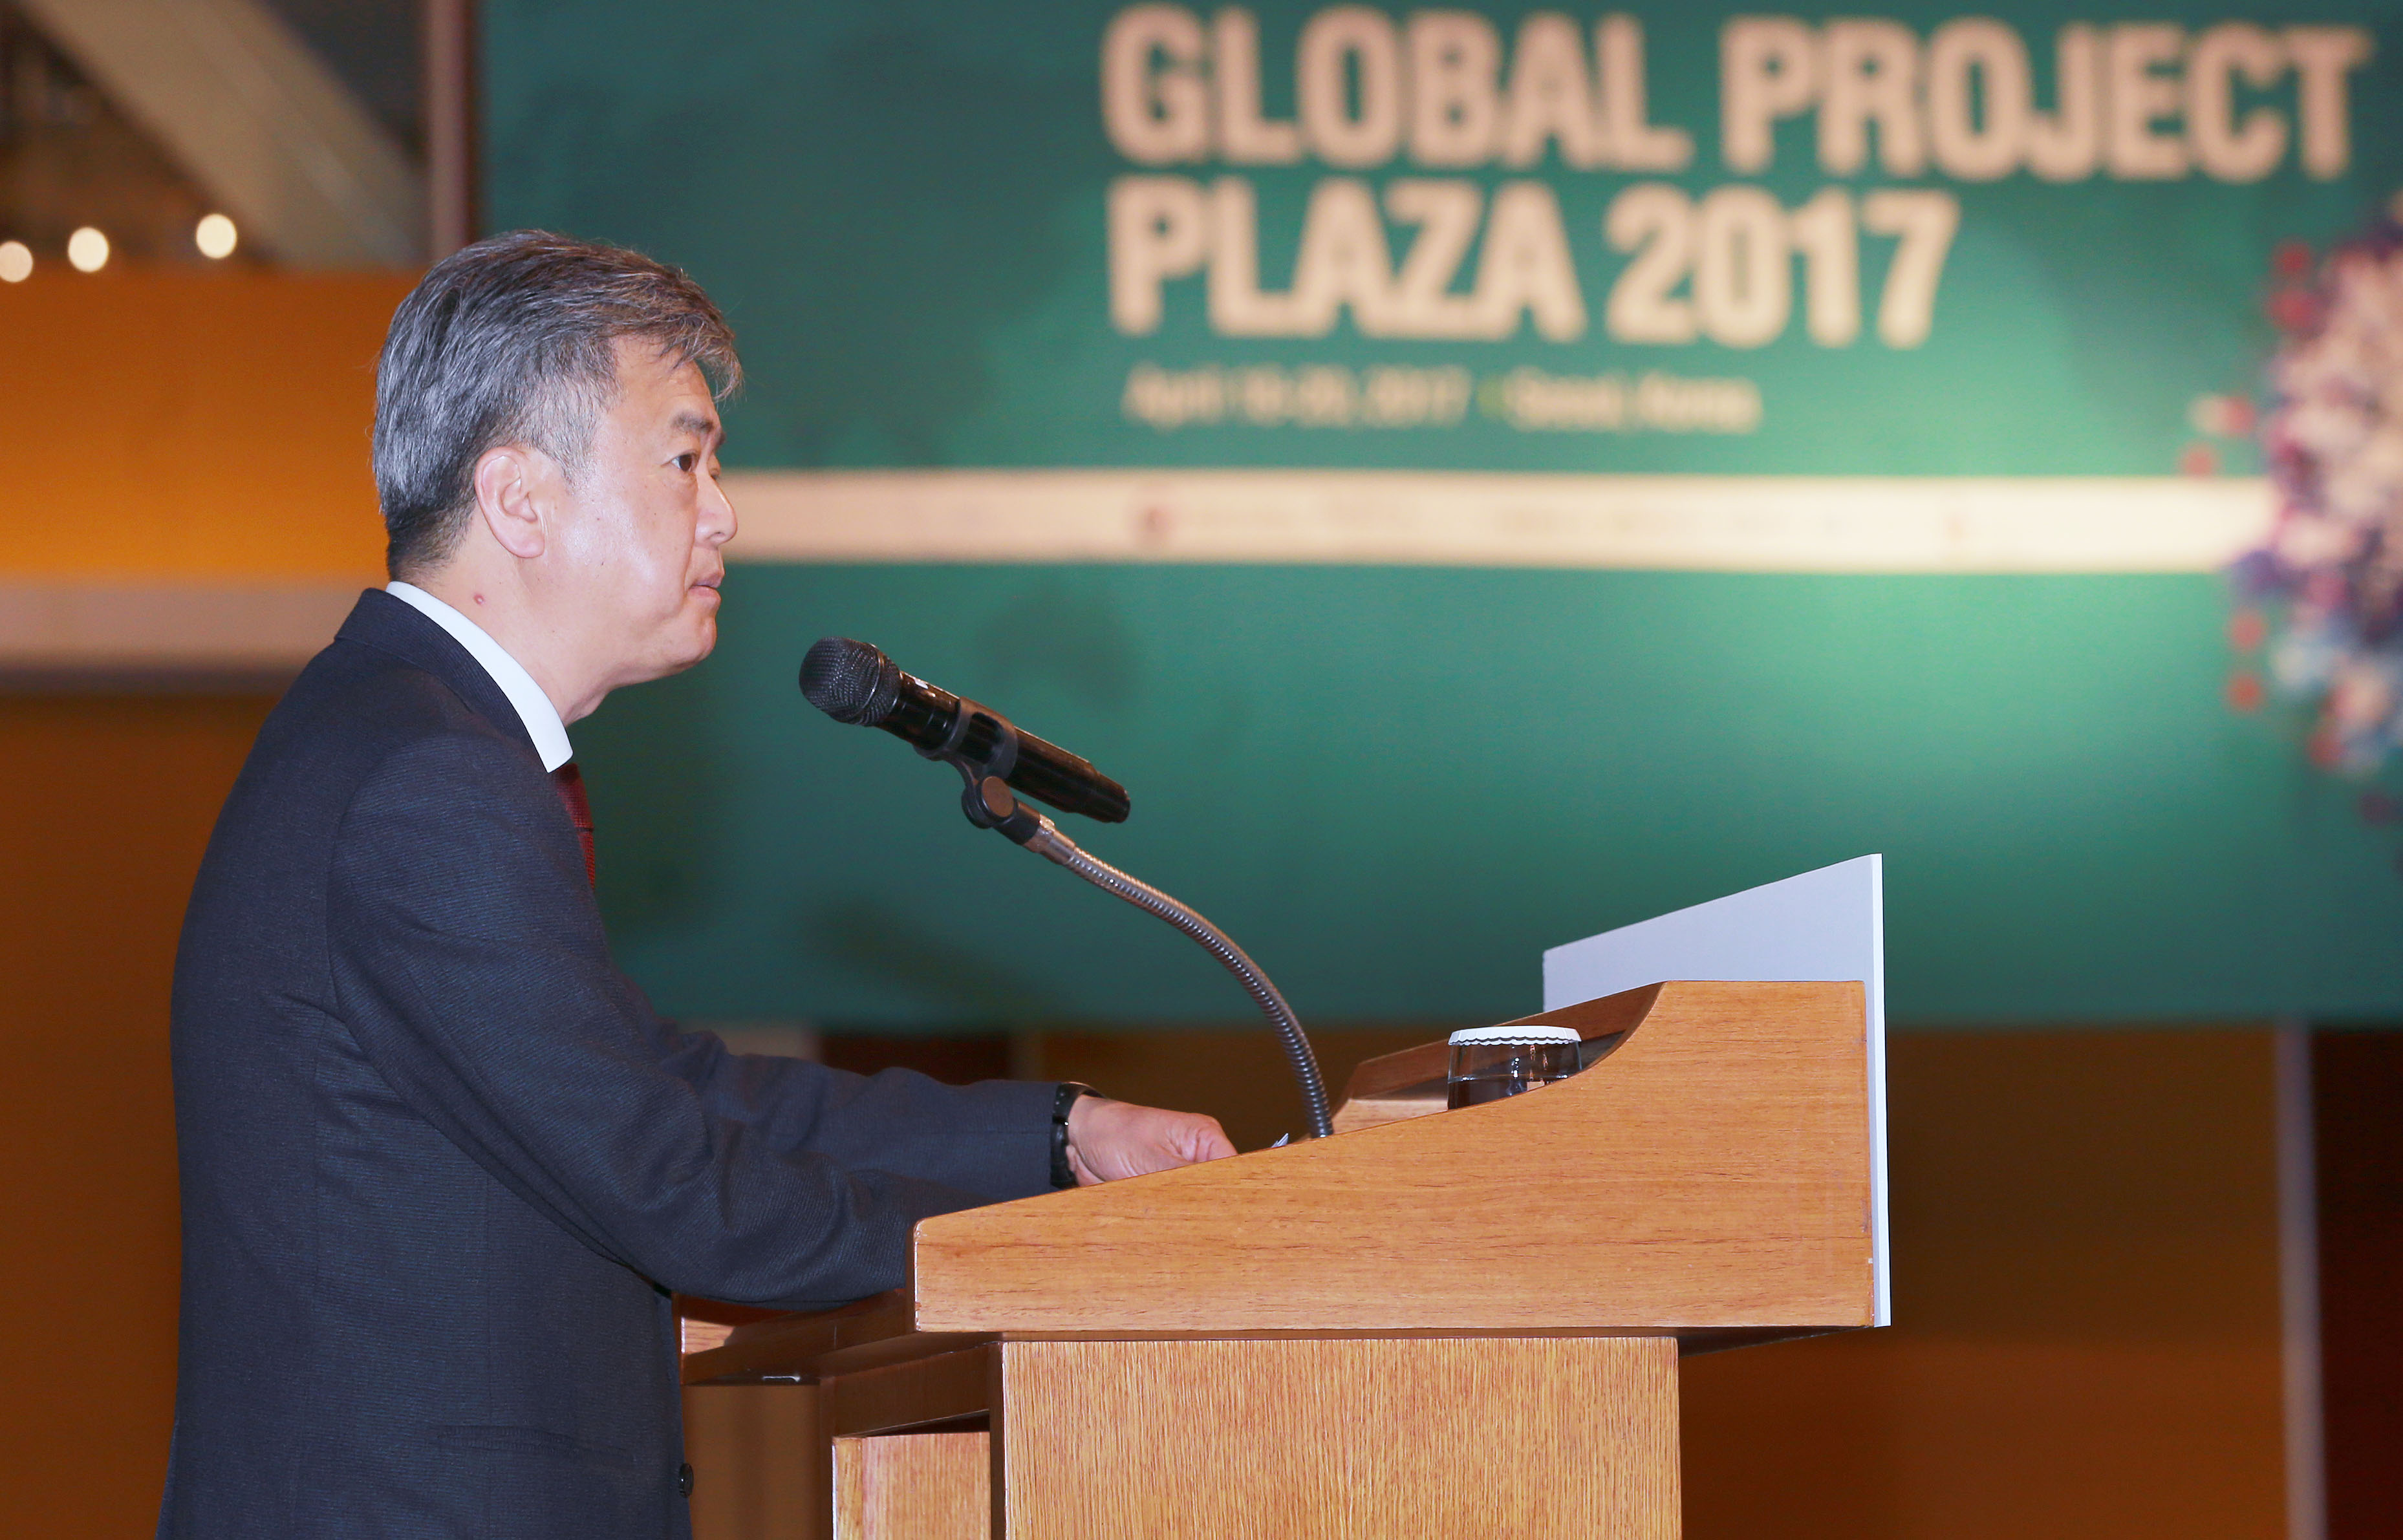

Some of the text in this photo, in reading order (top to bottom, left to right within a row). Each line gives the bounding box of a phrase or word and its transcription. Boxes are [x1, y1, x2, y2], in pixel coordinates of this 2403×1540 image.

[1103, 5, 2369, 182] GLOBAL PROJECT
[1108, 176, 1958, 348] PLAZA 2017
